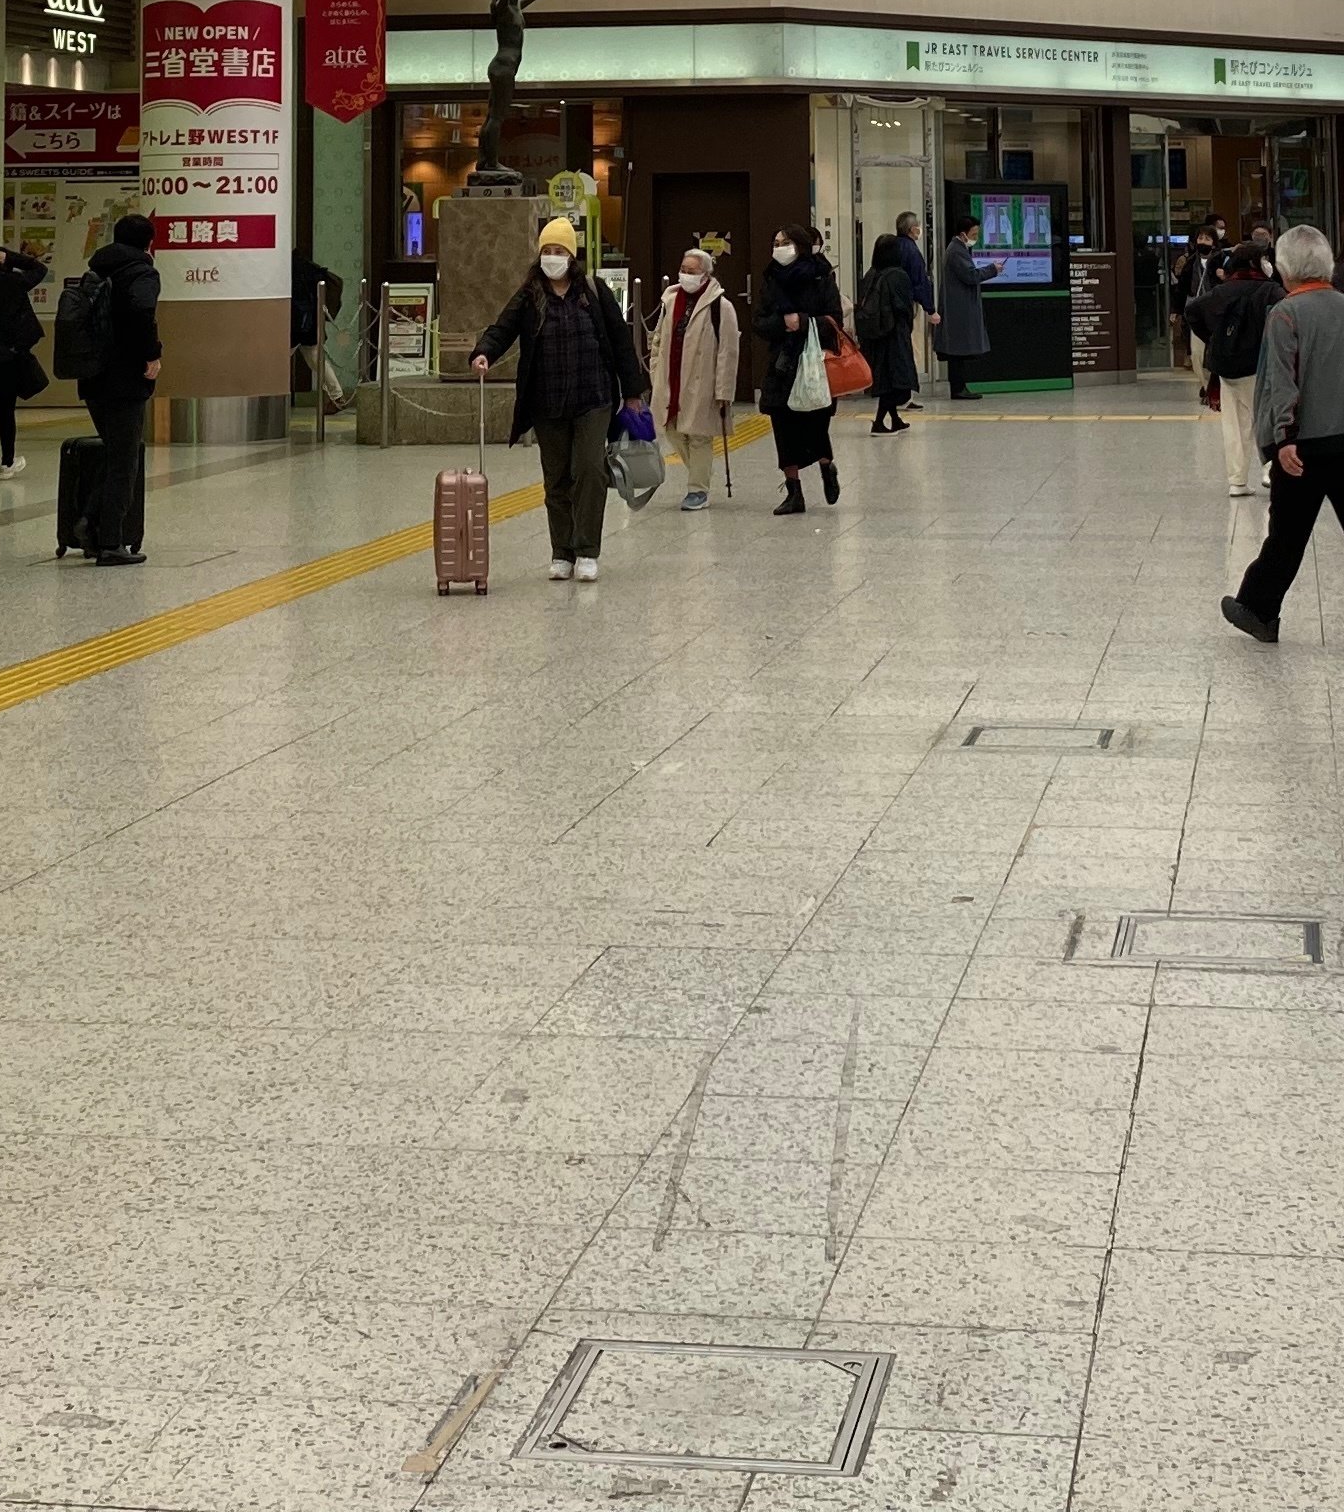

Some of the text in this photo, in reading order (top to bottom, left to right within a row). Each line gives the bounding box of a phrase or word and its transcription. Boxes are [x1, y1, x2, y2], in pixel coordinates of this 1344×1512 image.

[52, 28, 97, 54] WEST
[164, 25, 249, 40] NEW OPEN
[325, 45, 367, 64] atré
[924, 42, 938, 55] JR
[942, 43, 968, 56] EAST
[972, 44, 1013, 59] TRAVEL
[1015, 47, 1058, 61] SERVICE
[1060, 49, 1099, 63] CENTER
[145, 47, 276, 78] 三省堂書店
[1230, 59, 1313, 78] 駅たびコンシェルジュ
[32, 131, 80, 150] こちら
[62, 167, 94, 176] GUIDE
[182, 156, 224, 168] 営業時間
[168, 219, 239, 244] 通路奥
[185, 267, 220, 283] atré
